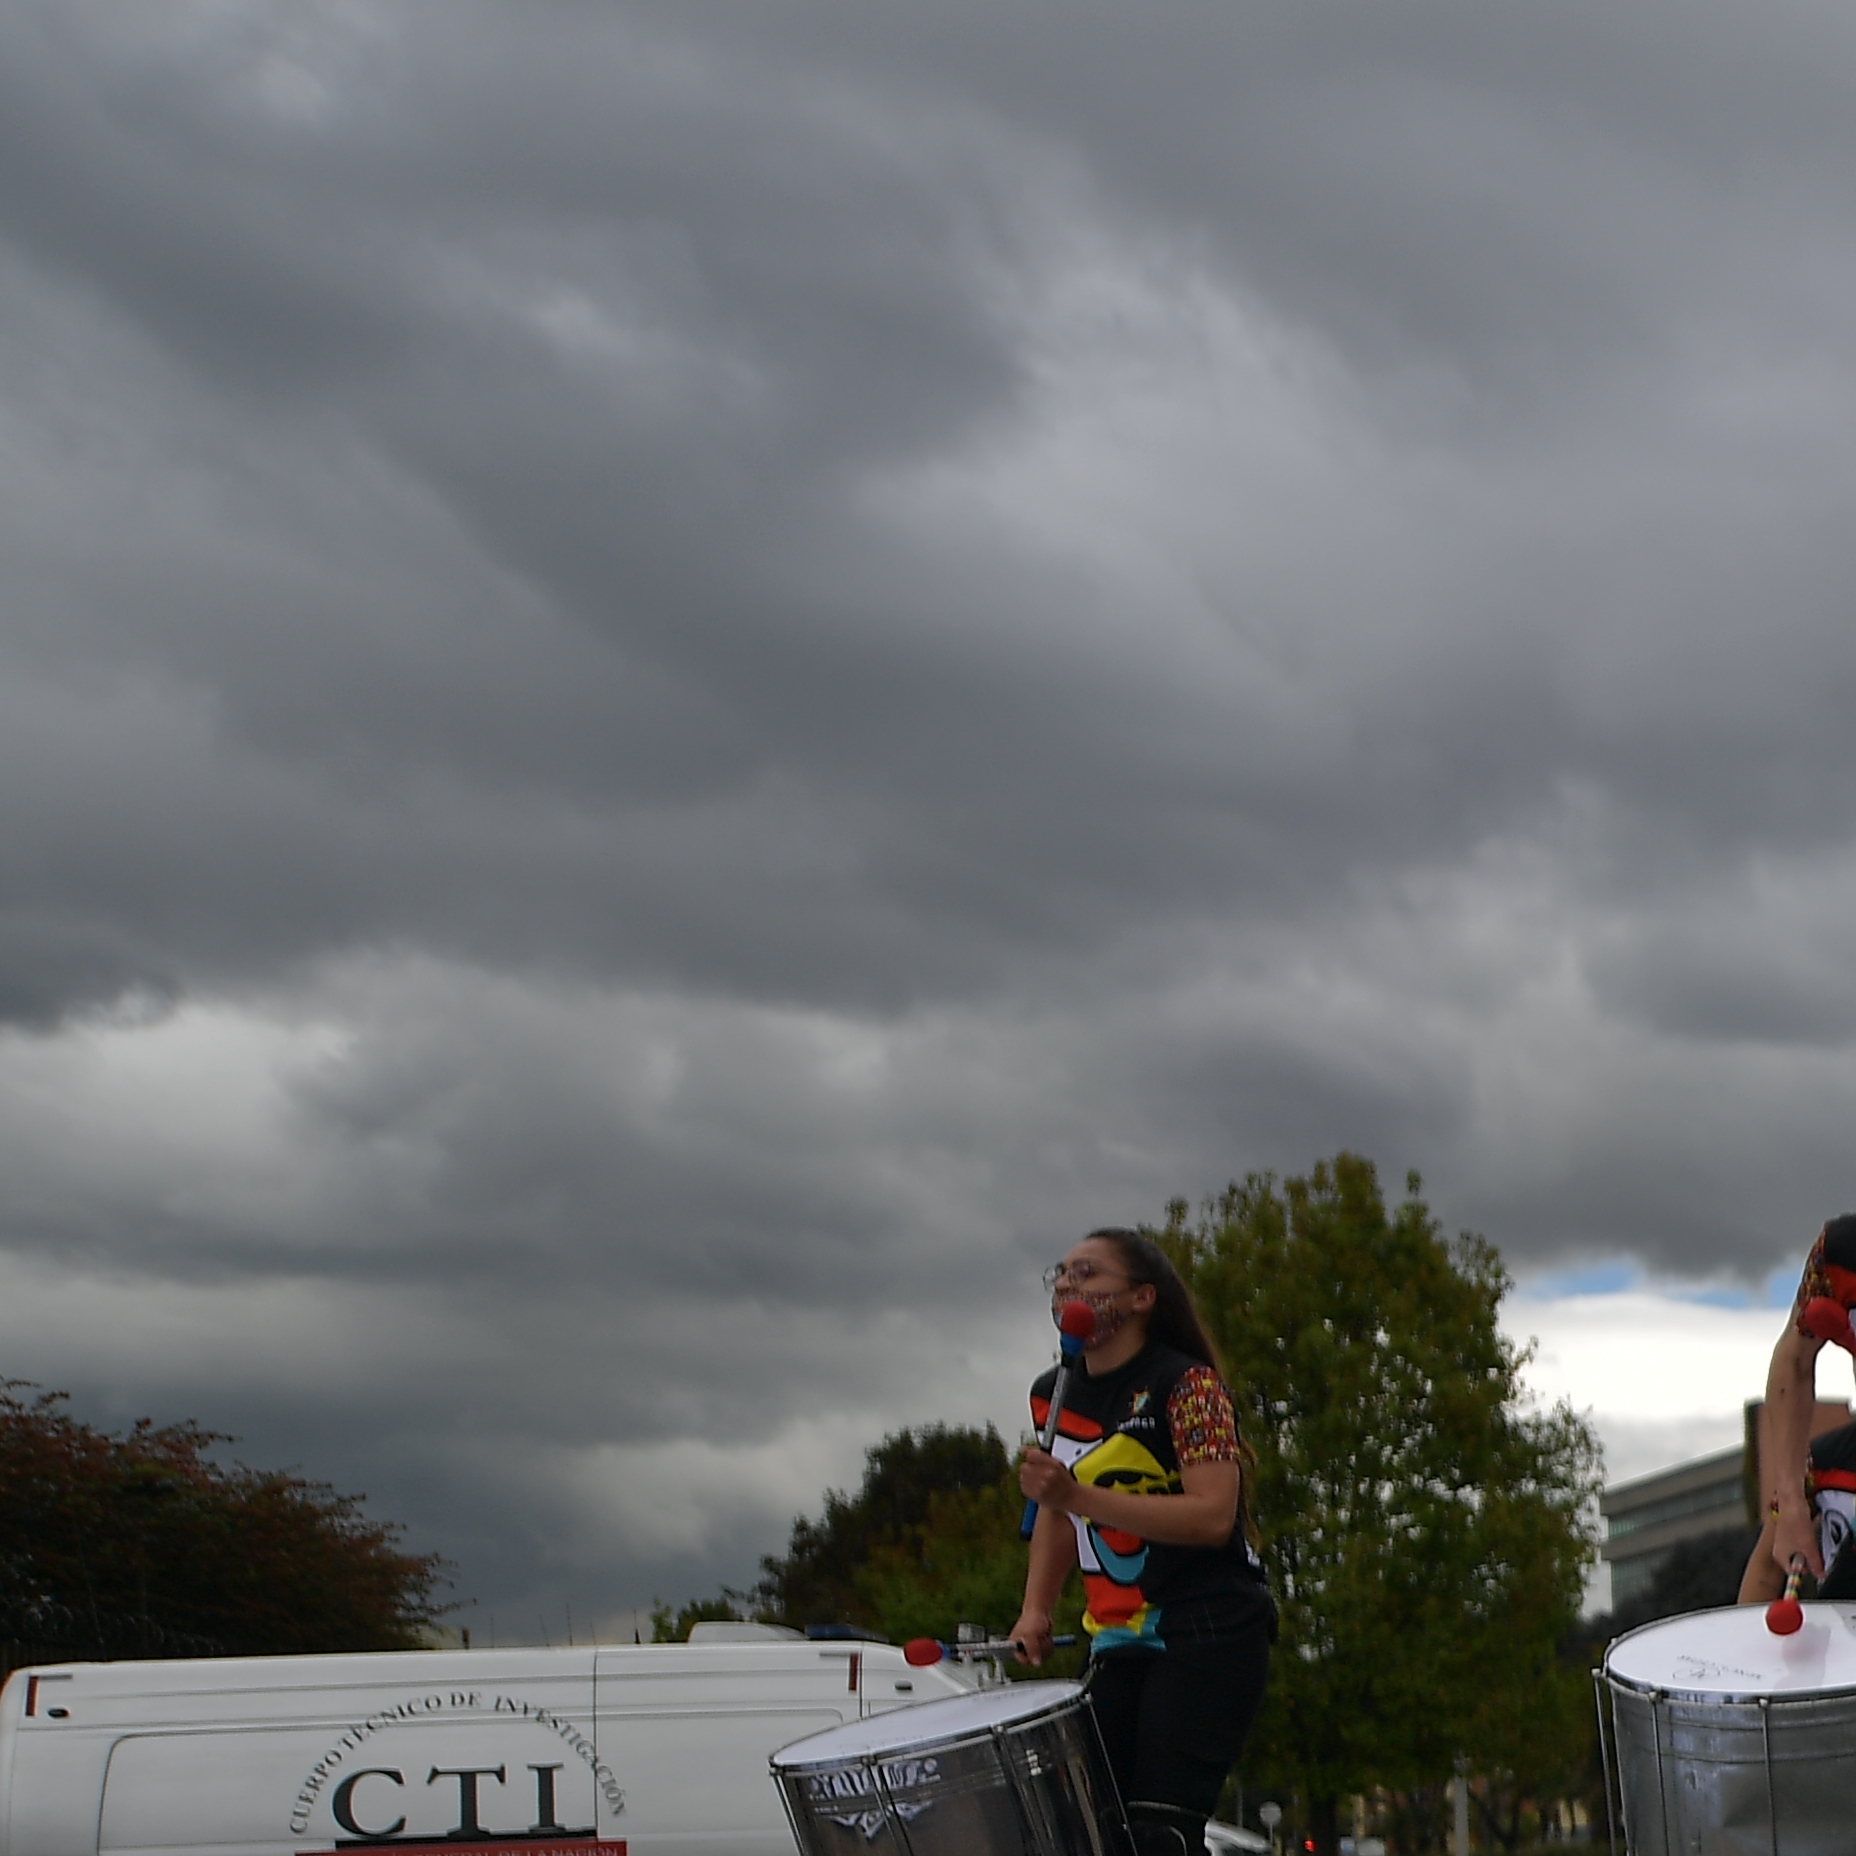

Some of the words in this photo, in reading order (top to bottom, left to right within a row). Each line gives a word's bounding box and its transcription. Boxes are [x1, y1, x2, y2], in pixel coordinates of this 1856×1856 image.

[289, 1748, 343, 1836] CUERPO
[450, 1691, 482, 1709] DE
[331, 1761, 566, 1842] CTI
